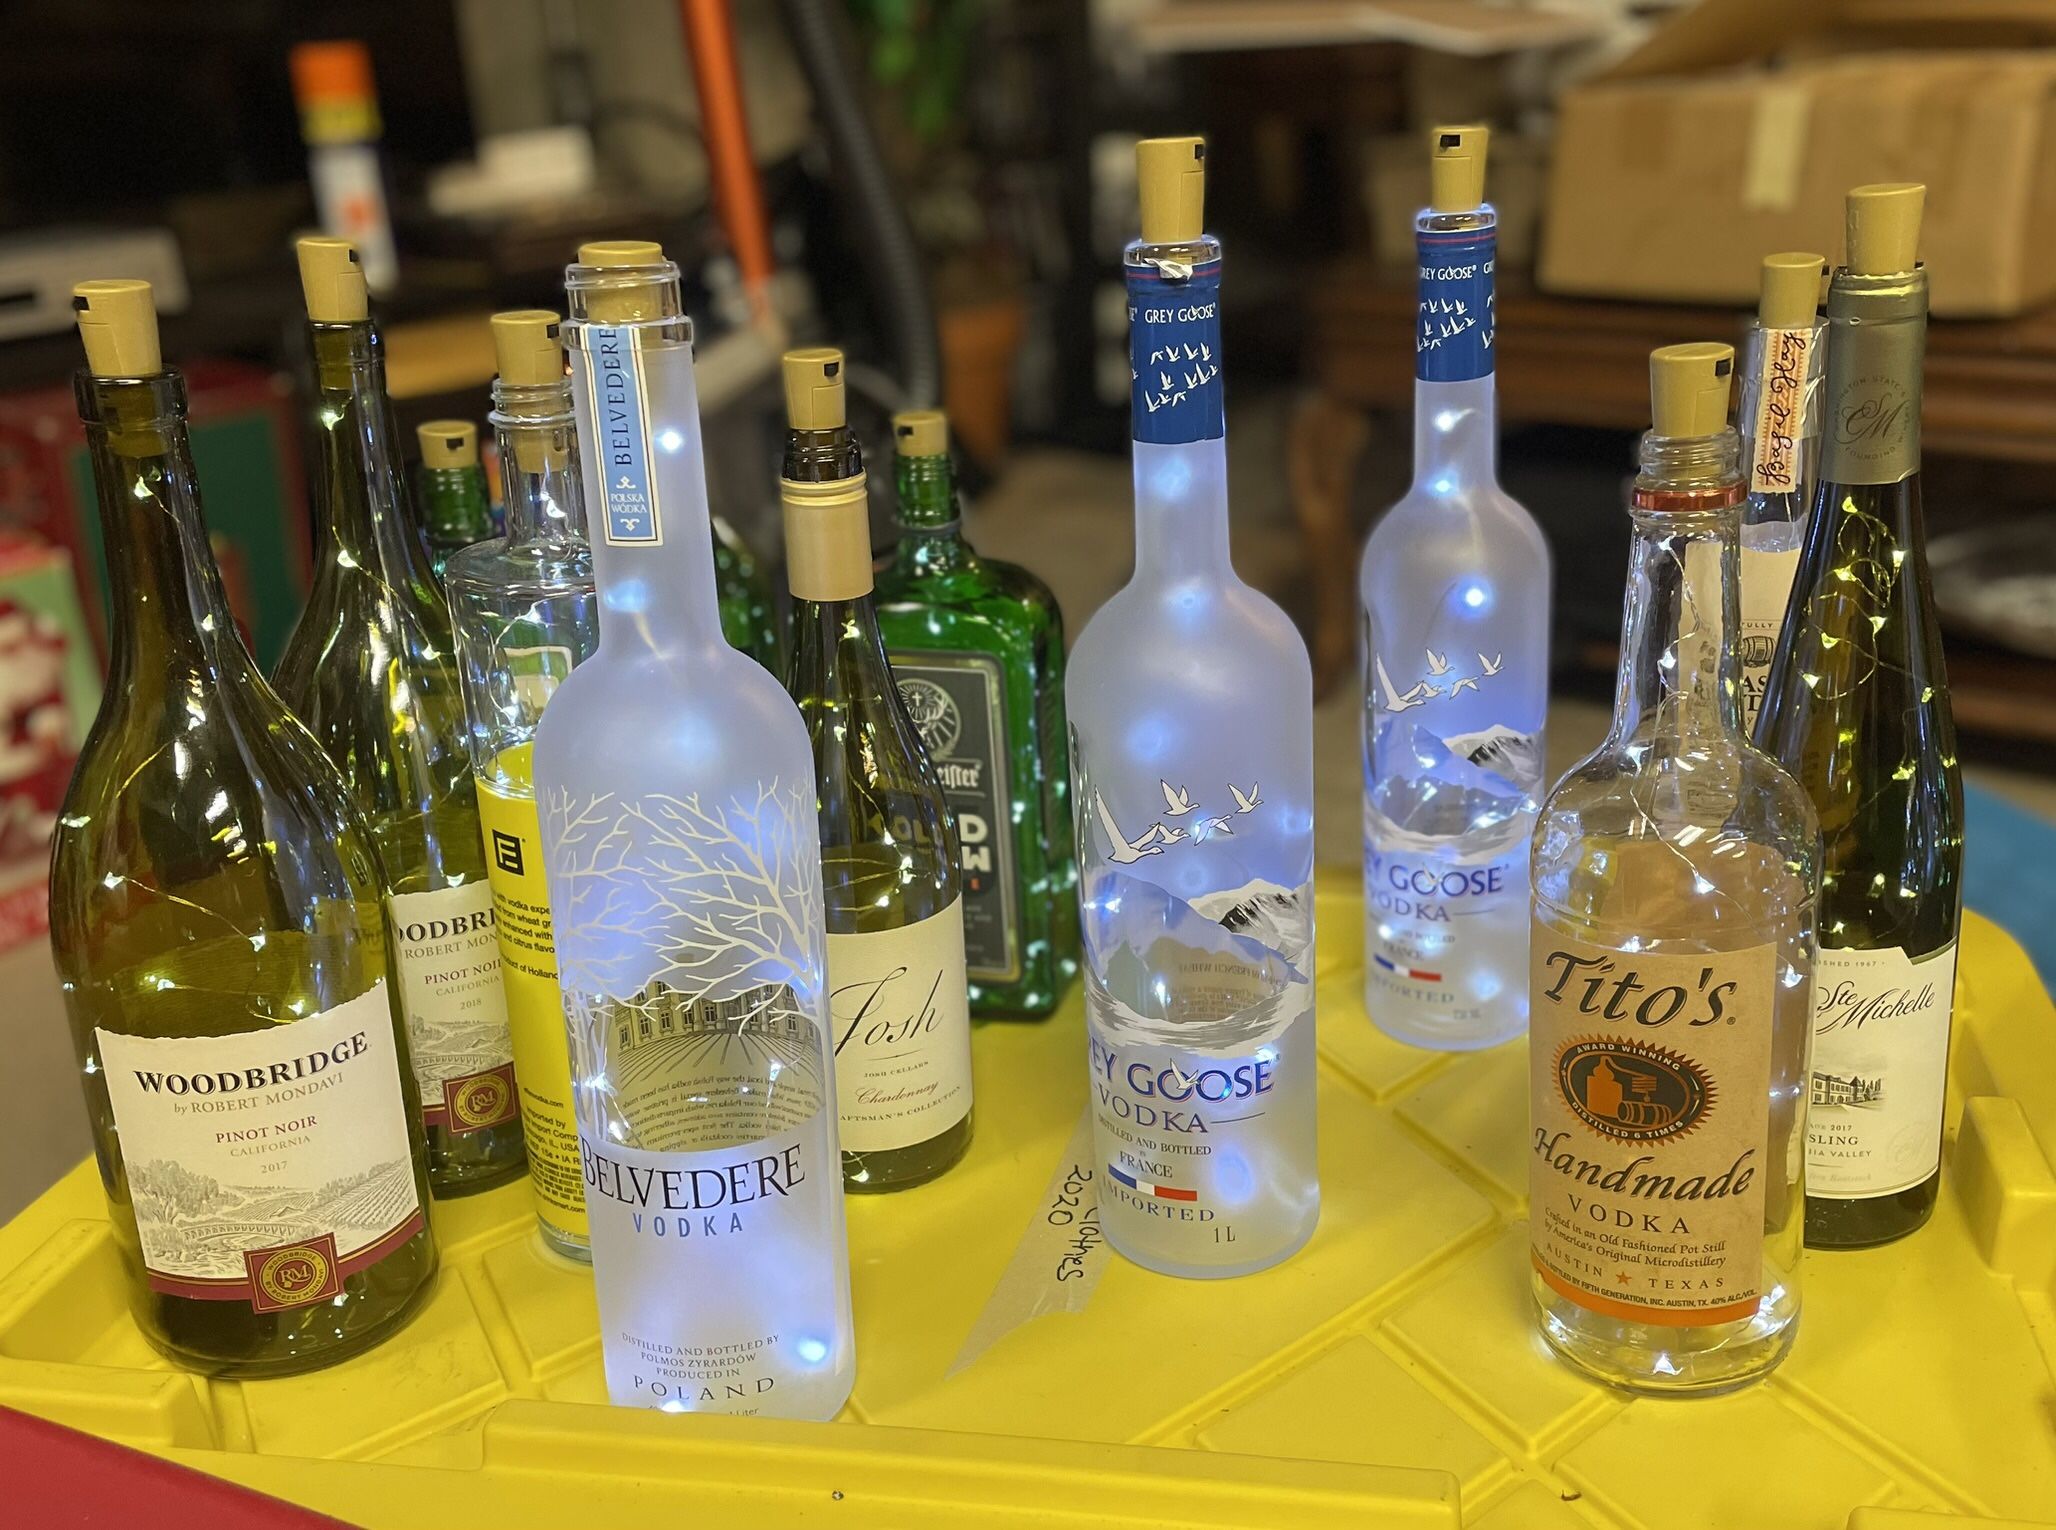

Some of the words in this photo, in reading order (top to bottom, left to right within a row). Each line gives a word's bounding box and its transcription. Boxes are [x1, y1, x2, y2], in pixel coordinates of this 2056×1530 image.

[1144, 308, 1174, 324] GREY
[599, 328, 632, 466] BELVEDERE
[611, 493, 645, 503] POLSKA
[611, 502, 647, 514] WÓDKA
[517, 914, 540, 926] wheat
[404, 940, 466, 960] ROBERT
[424, 968, 468, 985] PINOT
[436, 975, 500, 996] CALIFORNIA
[1544, 951, 1737, 1027] Tito's
[460, 998, 482, 1010] 2018
[830, 966, 945, 1058] Josh
[1816, 980, 1858, 1012] Ste
[1841, 982, 1936, 1030] Michelle
[133, 1031, 368, 1096] WOODBRIDGE
[890, 1061, 929, 1076] CELLARS
[1576, 1043, 1615, 1054] AWARD
[1622, 1045, 1681, 1071] WINNING
[174, 1103, 188, 1115] by
[191, 1097, 260, 1113] ROBERT
[266, 1072, 344, 1106] MONDAVI
[855, 1080, 940, 1105] Chardonnay
[1127, 1060, 1275, 1104] GOOSE
[906, 1085, 961, 1116] COLLECTION
[1099, 1084, 1209, 1134] VODKA
[215, 1127, 269, 1143] PINOT
[275, 1116, 317, 1135] NOIR
[556, 1119, 566, 1130] by
[1571, 1102, 1628, 1137] DISTILLED
[1647, 1120, 1683, 1138] TIMES
[1830, 1124, 1852, 1132] 2017
[230, 1135, 310, 1157] CALIFORNIA
[560, 1142, 581, 1153] USA
[1135, 1136, 1157, 1151] AND
[1160, 1142, 1212, 1156] BOTTLED
[1830, 1150, 1872, 1158] VALLEY
[261, 1161, 288, 1174] 2017
[580, 1136, 806, 1210] BELVEDERE
[1119, 1150, 1173, 1179] FRANCE
[1534, 1128, 1755, 1201] Handmade
[1047, 1164, 1093, 1225] 2020
[1103, 1176, 1215, 1222] IMPORTED
[632, 1212, 743, 1238] VODKA
[1567, 1193, 1690, 1234] VODKA
[1213, 1227, 1221, 1243] 1
[1226, 1225, 1236, 1242] L
[1572, 1224, 1582, 1235] in
[1584, 1230, 1596, 1240] an
[1599, 1234, 1619, 1246] Old
[1622, 1238, 1677, 1254] Fashioned
[1680, 1244, 1699, 1254] Pot
[1702, 1240, 1727, 1252] Still
[1553, 1227, 1593, 1252] America's
[1596, 1246, 1641, 1263] Original
[1645, 1255, 1727, 1269] Microdistillery
[1546, 1242, 1602, 1277] AUSTIN
[1648, 1277, 1724, 1290] TEXAS
[1581, 1281, 1600, 1294] FIFTH
[1601, 1287, 1648, 1305] GENERATION,
[1666, 1299, 1697, 1308] AUSTIN,
[622, 1332, 673, 1354] DISTILLED
[676, 1347, 703, 1356] AND
[708, 1339, 763, 1356] BOTTLED
[766, 1334, 779, 1345] BY
[641, 1351, 684, 1368] POLMOS
[656, 1367, 722, 1380] PRODUCED
[726, 1368, 741, 1377] IN
[634, 1375, 774, 1401] POLAND
